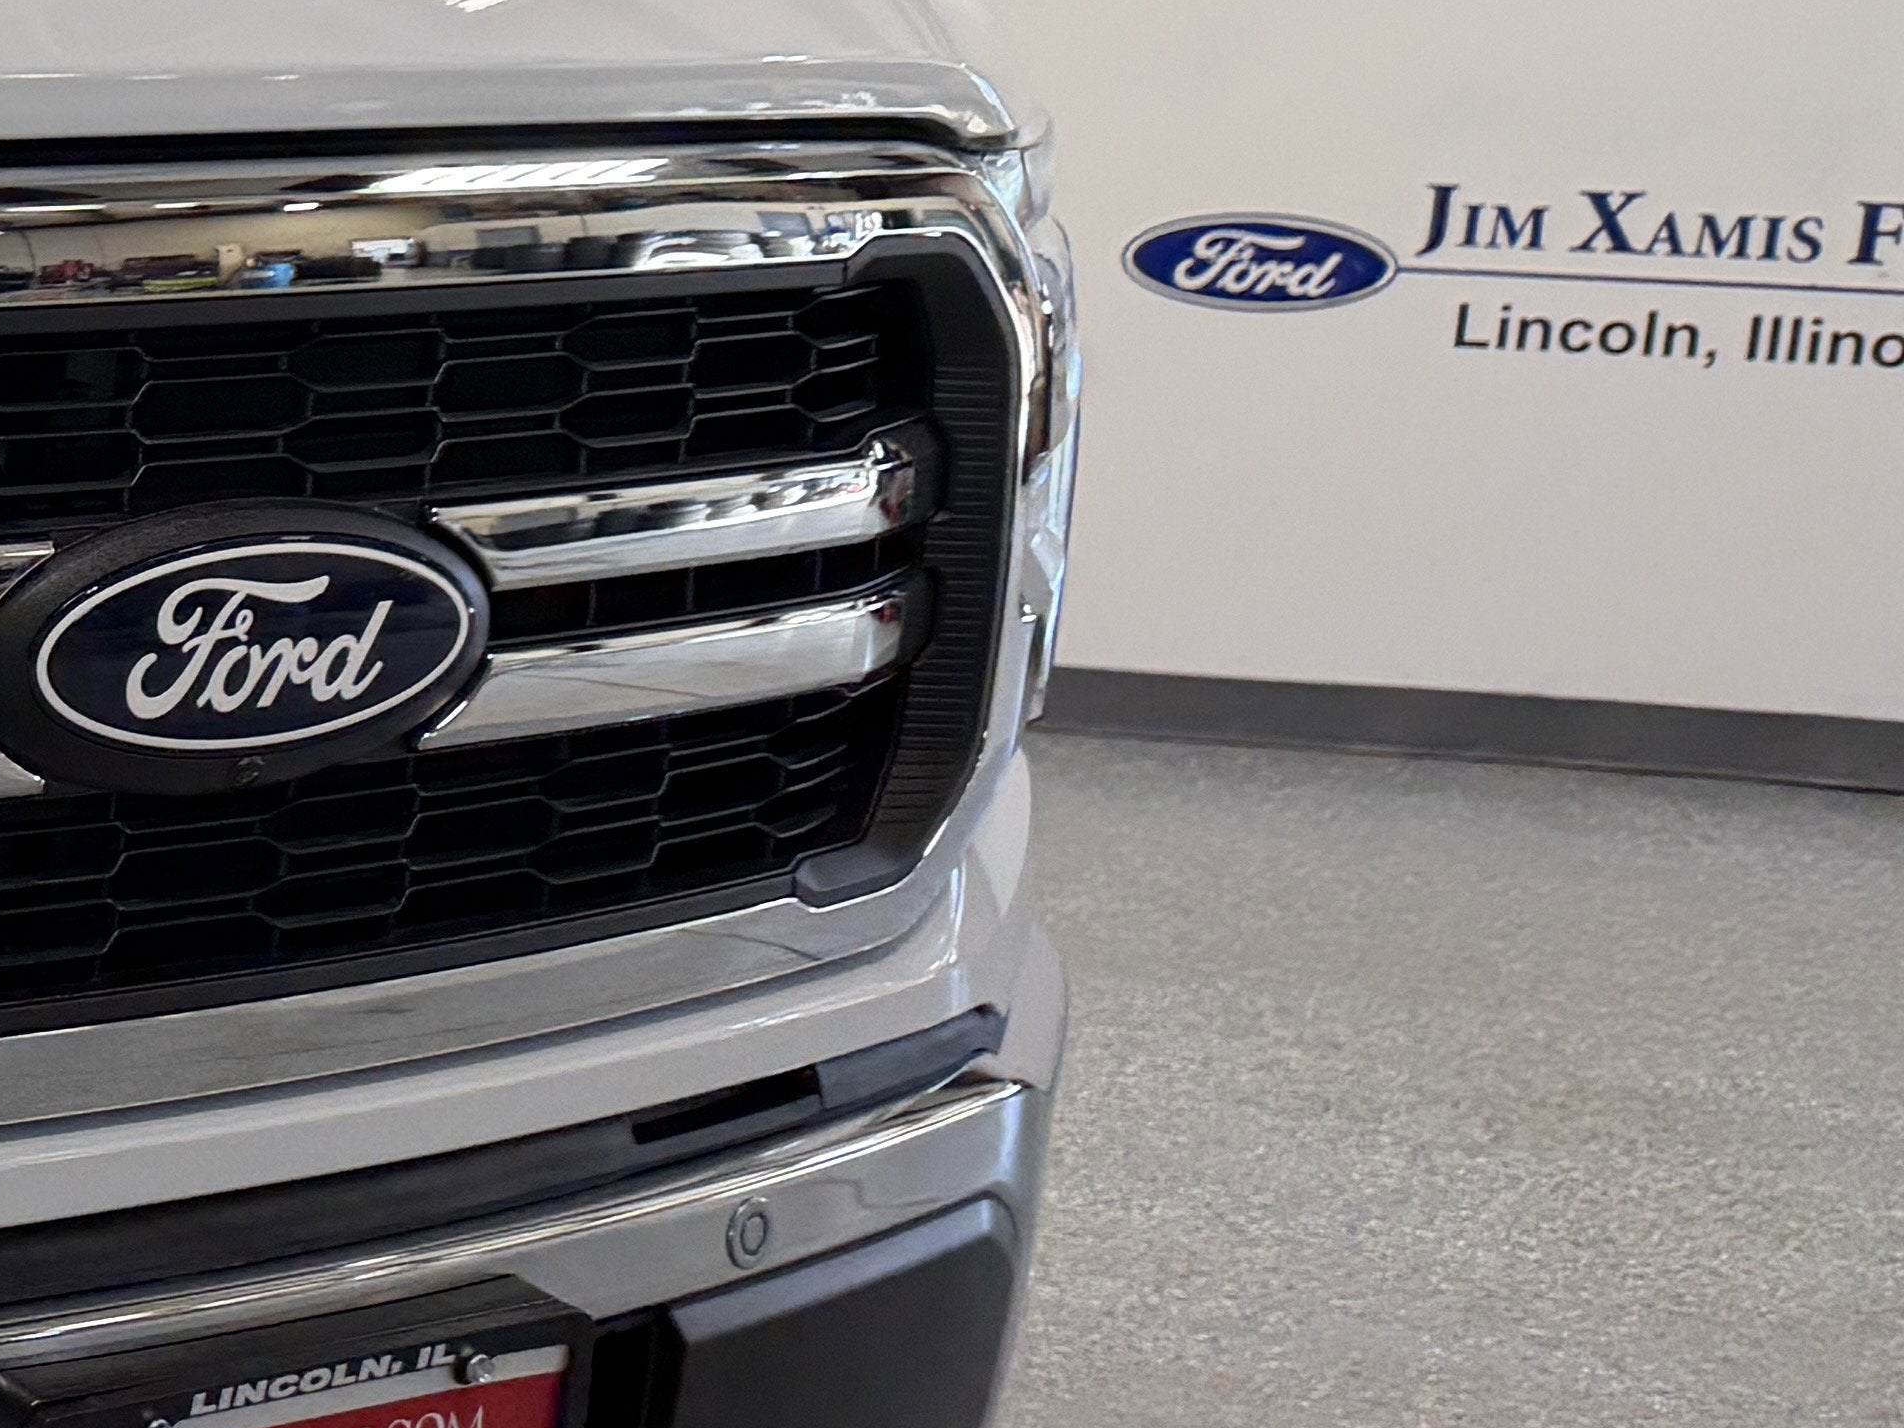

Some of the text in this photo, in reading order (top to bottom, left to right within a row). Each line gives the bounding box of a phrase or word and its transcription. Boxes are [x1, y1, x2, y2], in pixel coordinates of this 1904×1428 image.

[1416, 183, 1550, 257] JIM
[1569, 190, 1824, 263] XAMIS
[1173, 229, 1343, 299] Ford
[1453, 302, 1904, 368] Lincoln, Illino
[126, 575, 393, 719] Ford
[190, 1344, 456, 1416] LINCOLN, IL
